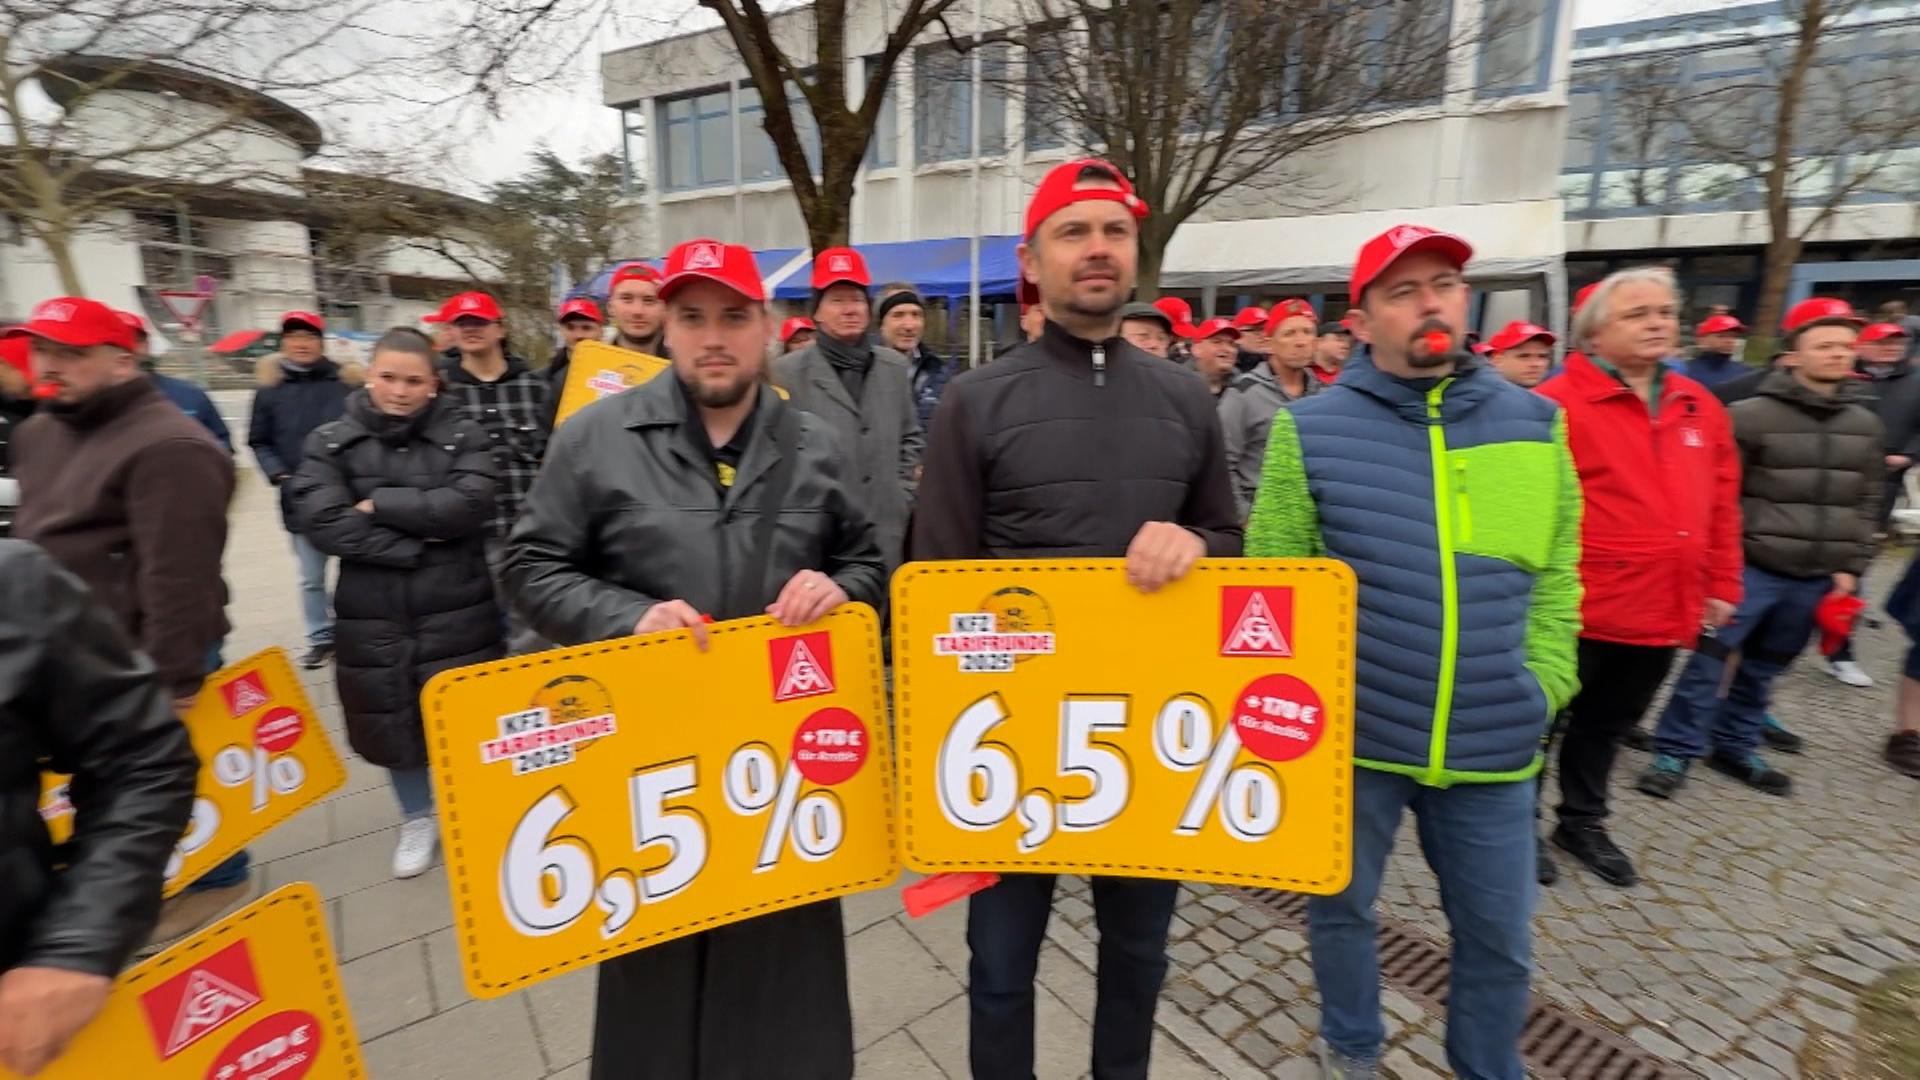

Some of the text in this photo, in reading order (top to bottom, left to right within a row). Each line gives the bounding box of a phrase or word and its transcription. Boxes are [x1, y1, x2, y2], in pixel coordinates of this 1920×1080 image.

[954, 615, 990, 632] KFZ
[936, 635, 1052, 652] TARIFRUNDE
[962, 654, 1009, 669] 2025
[503, 711, 543, 735] KFZ
[486, 717, 613, 760] TARIFRUNDE
[519, 745, 570, 771] 2025
